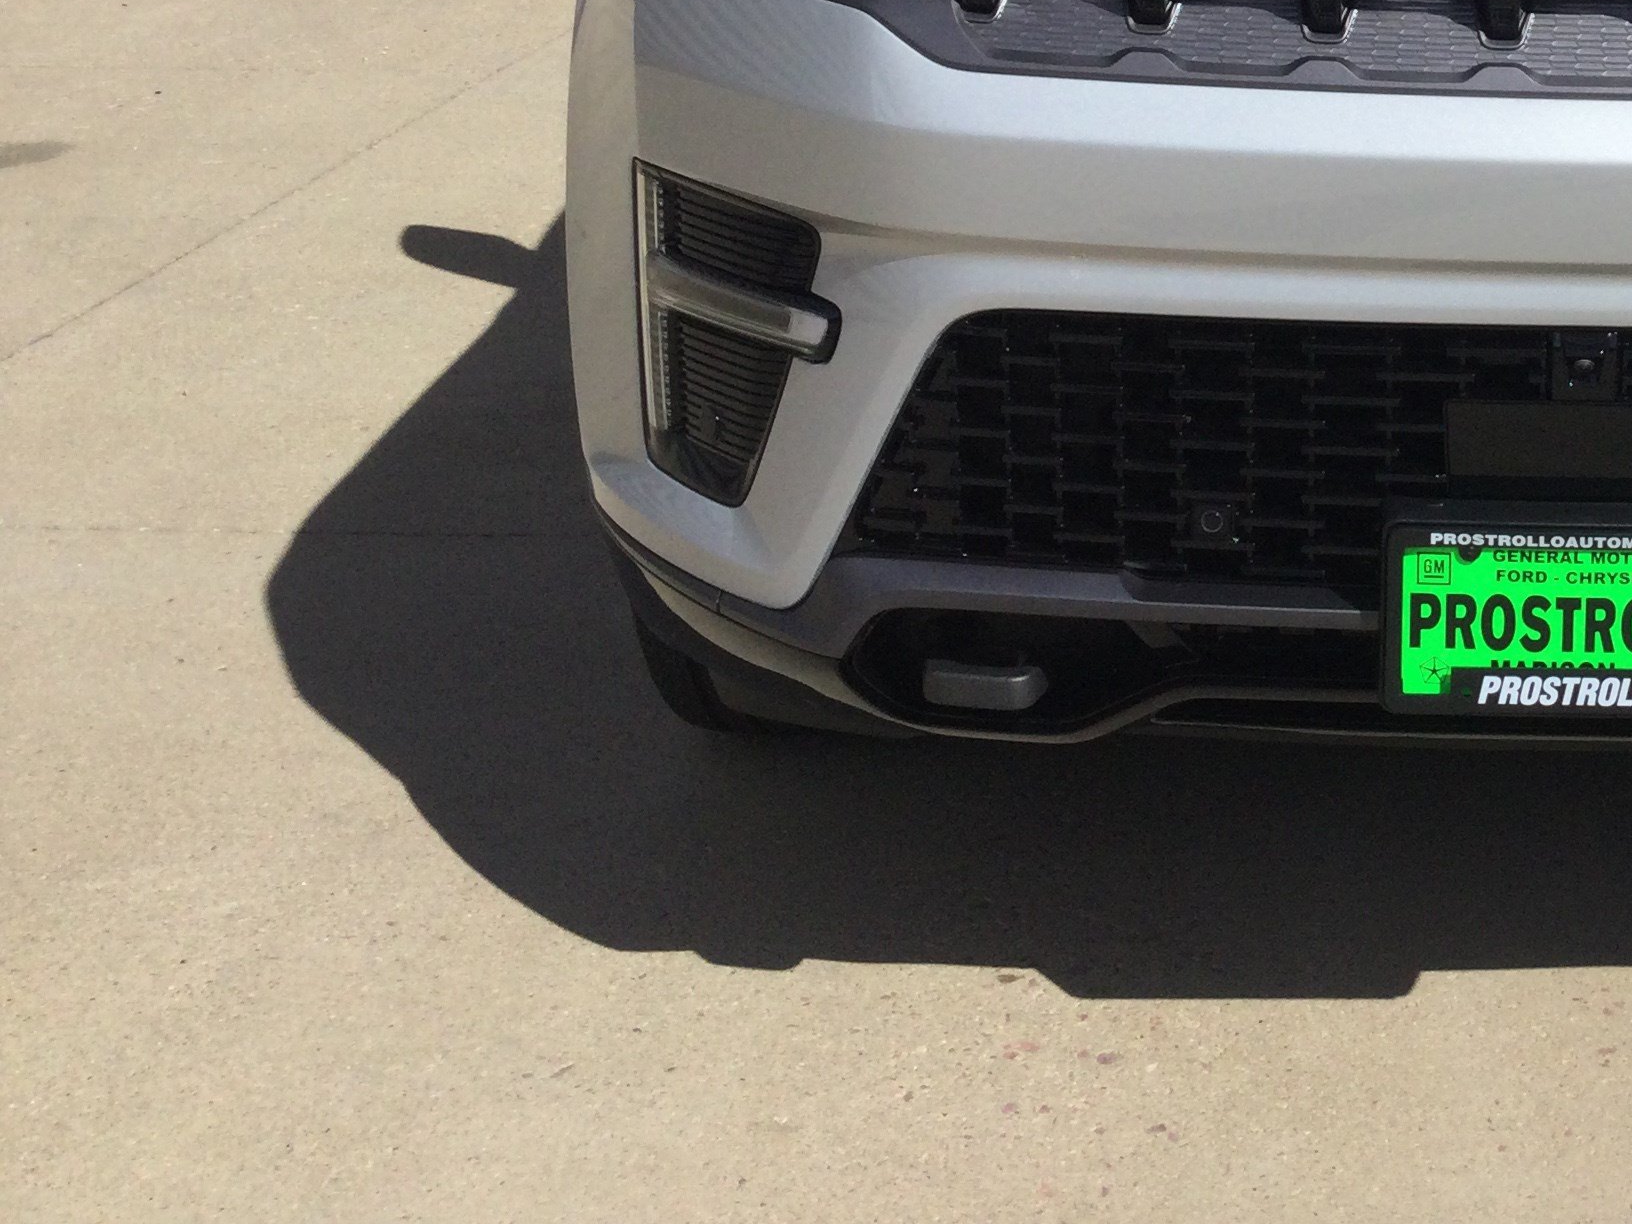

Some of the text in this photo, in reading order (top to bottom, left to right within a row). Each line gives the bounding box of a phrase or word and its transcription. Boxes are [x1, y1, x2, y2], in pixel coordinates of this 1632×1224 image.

[1492, 550, 1584, 565] GENERAL
[1423, 560, 1445, 575] GM
[1496, 569, 1548, 585] FORD
